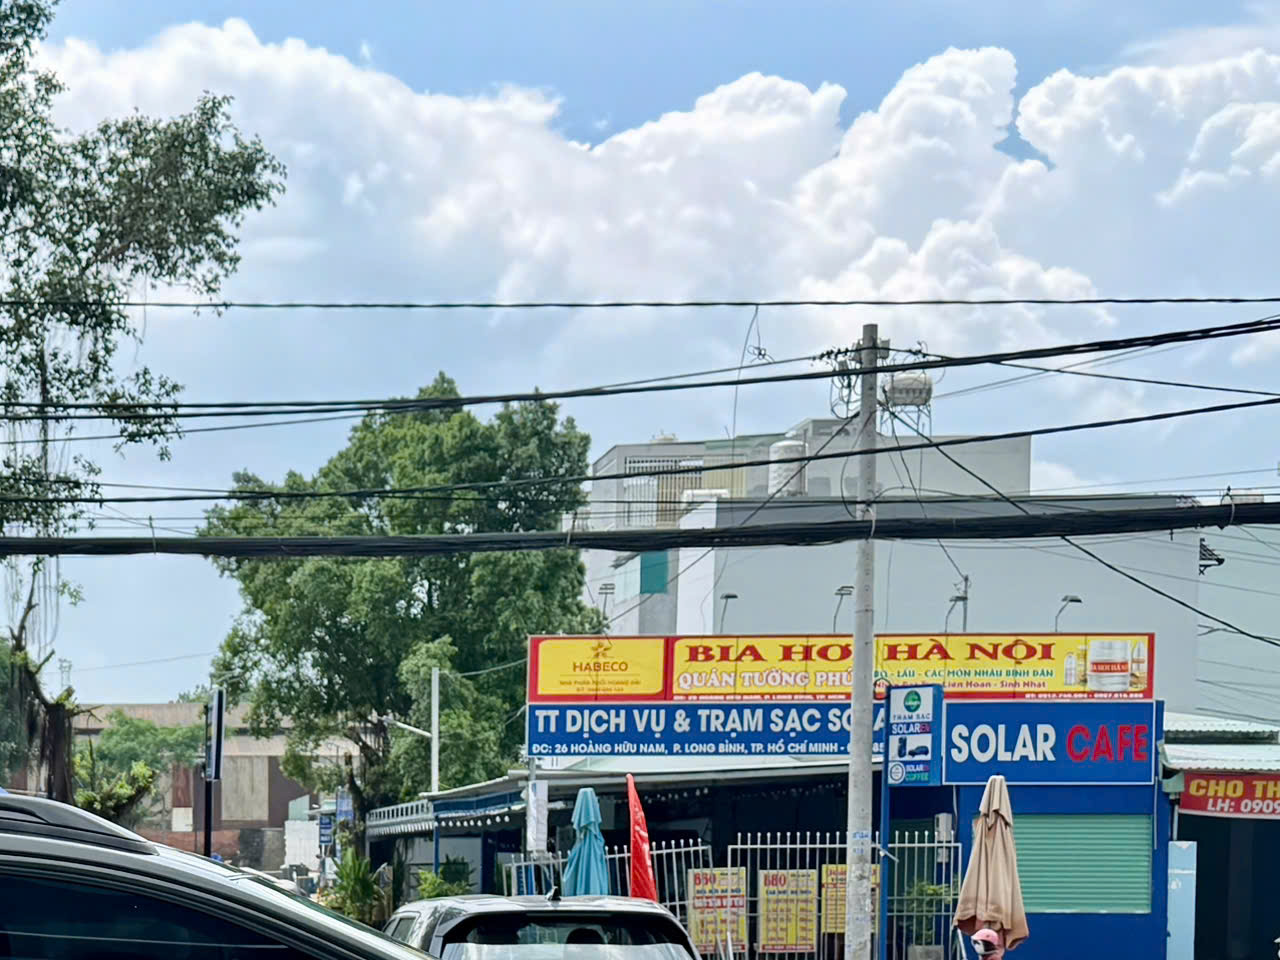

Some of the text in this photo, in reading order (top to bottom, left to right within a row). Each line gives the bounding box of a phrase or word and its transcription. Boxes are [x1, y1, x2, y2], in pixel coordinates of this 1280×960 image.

[686, 638, 1056, 665] BIA HƠ HÀ NỘI
[573, 661, 629, 673] HABECO
[535, 709, 559, 733] TT
[566, 709, 626, 738] DỊCH
[633, 709, 666, 738] VỤ
[673, 708, 690, 733] &
[697, 708, 764, 738] TRẠM
[770, 708, 821, 738] SẠC
[532, 743, 552, 753] ĐC:
[555, 743, 569, 753] 26
[571, 739, 612, 753] HOÀNG
[614, 740, 637, 753] HỮU
[639, 743, 668, 755] NAM,
[673, 742, 682, 753] P.
[684, 742, 716, 753] LONG
[718, 739, 748, 755] BÌNH,
[767, 739, 785, 753] HỒ
[787, 739, 808, 753] CHÍ
[809, 742, 838, 753] MINH
[950, 723, 1149, 763] SOLAR CAFE
[1189, 779, 1244, 798] CHO
[1207, 799, 1236, 812] LH:
